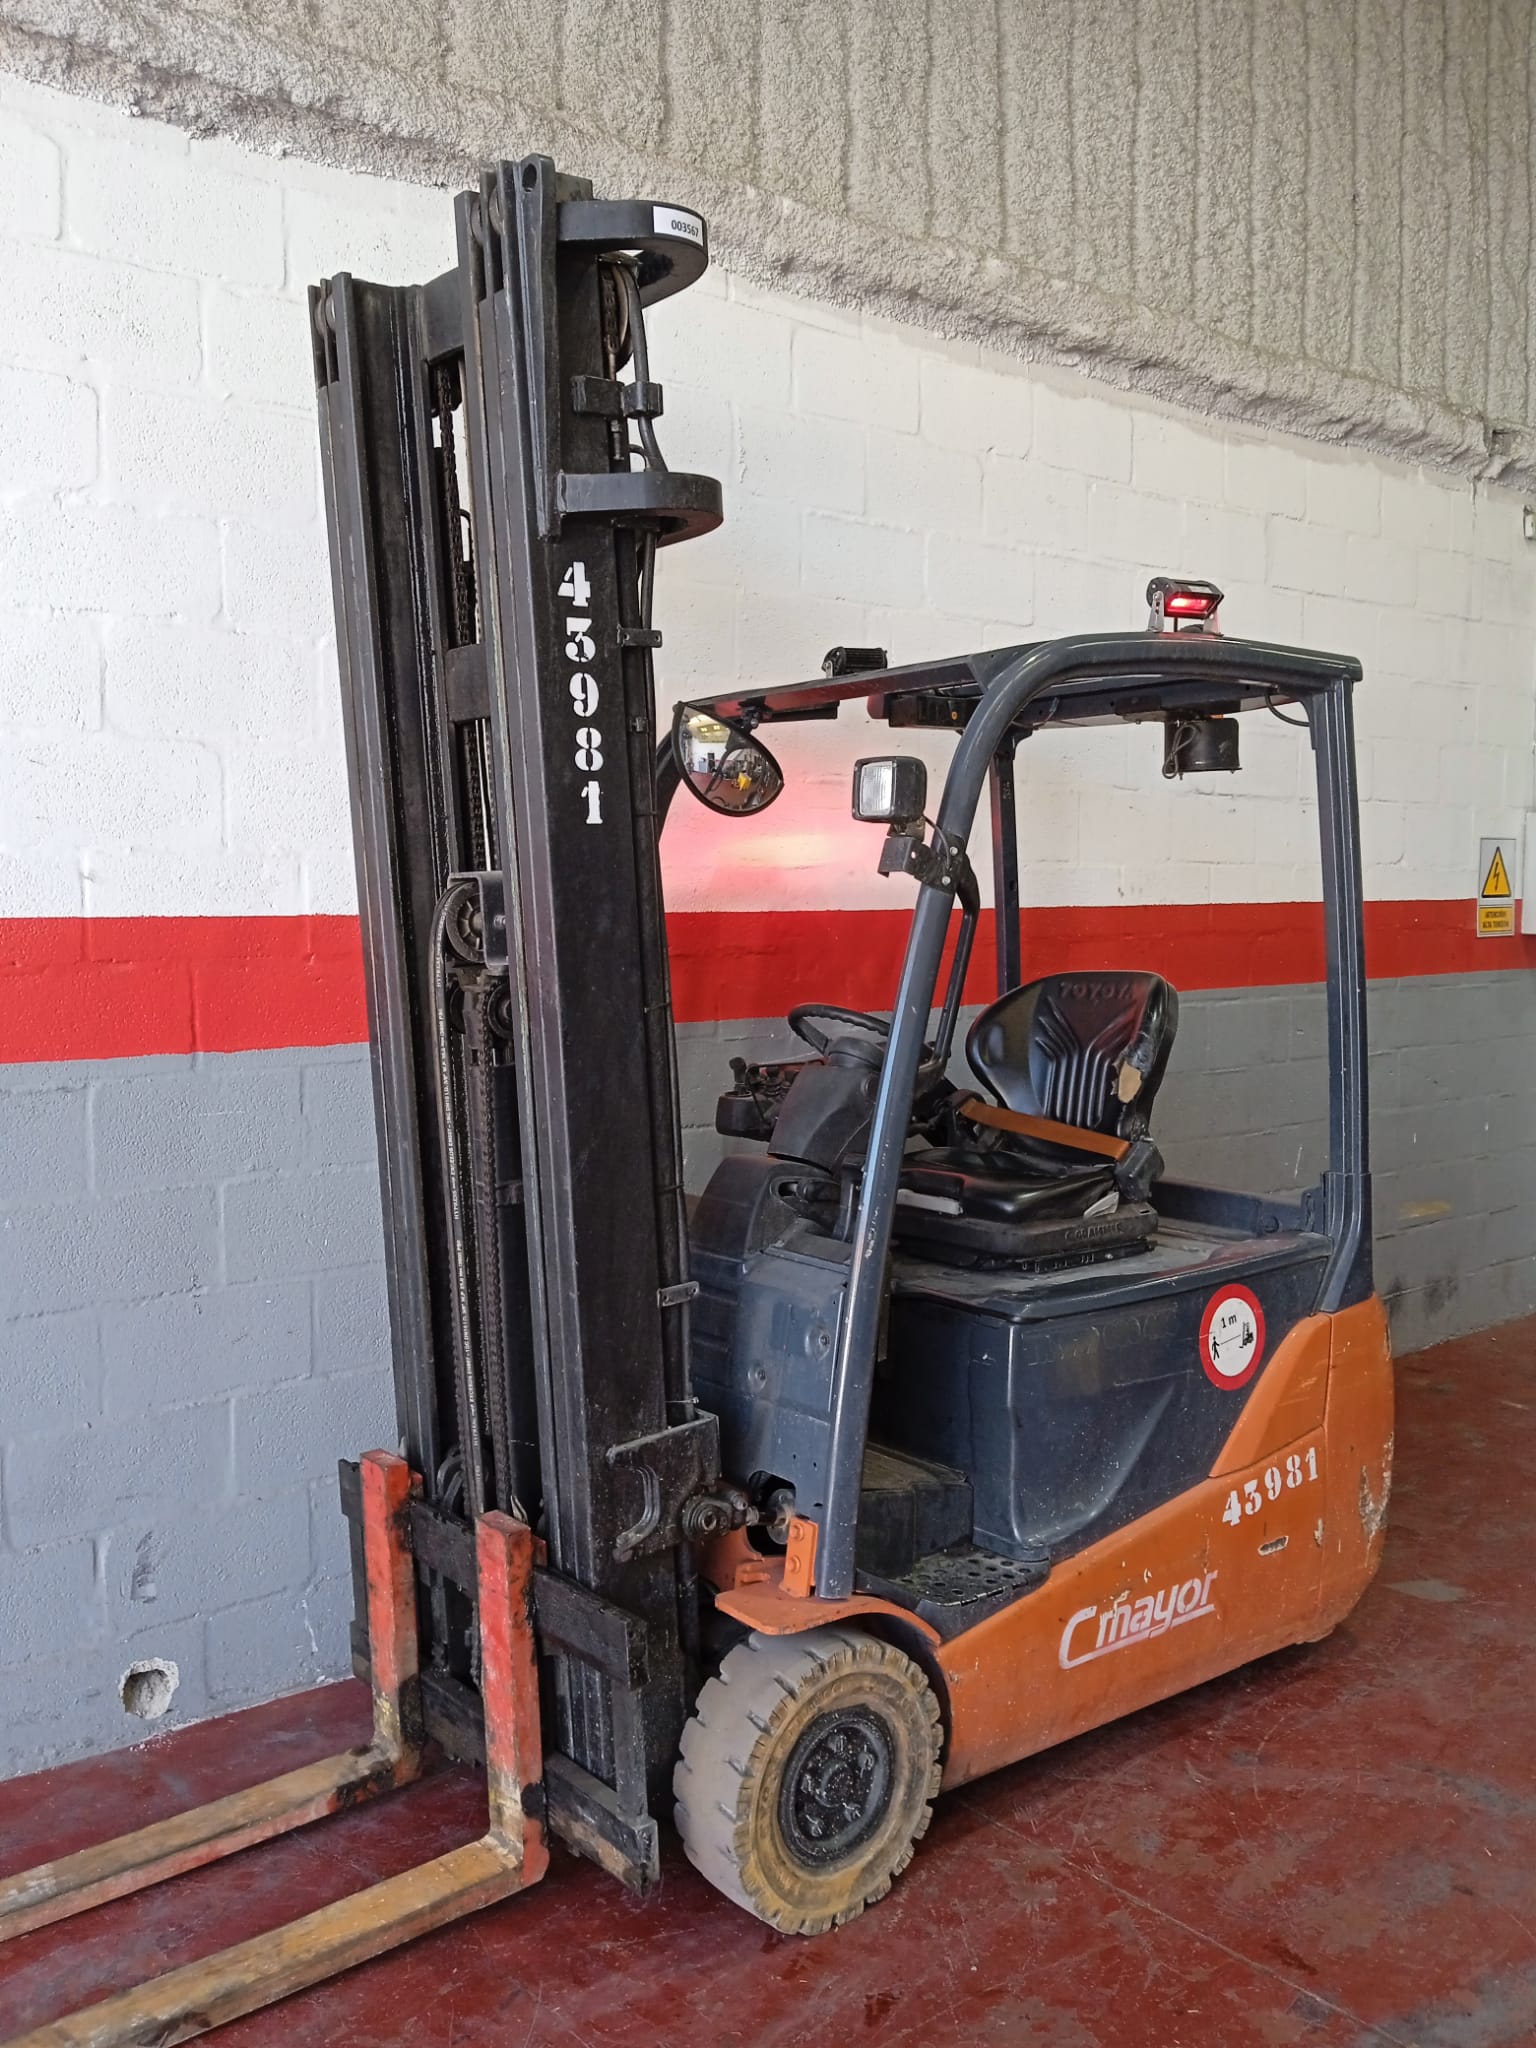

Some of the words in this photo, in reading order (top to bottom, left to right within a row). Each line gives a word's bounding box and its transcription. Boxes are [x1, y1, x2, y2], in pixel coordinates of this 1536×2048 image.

[671, 219, 699, 237] 003567
[557, 562, 604, 824] 43981
[1221, 1317, 1226, 1328] 1
[1228, 1314, 1237, 1325] m
[1222, 1447, 1318, 1526] 43981
